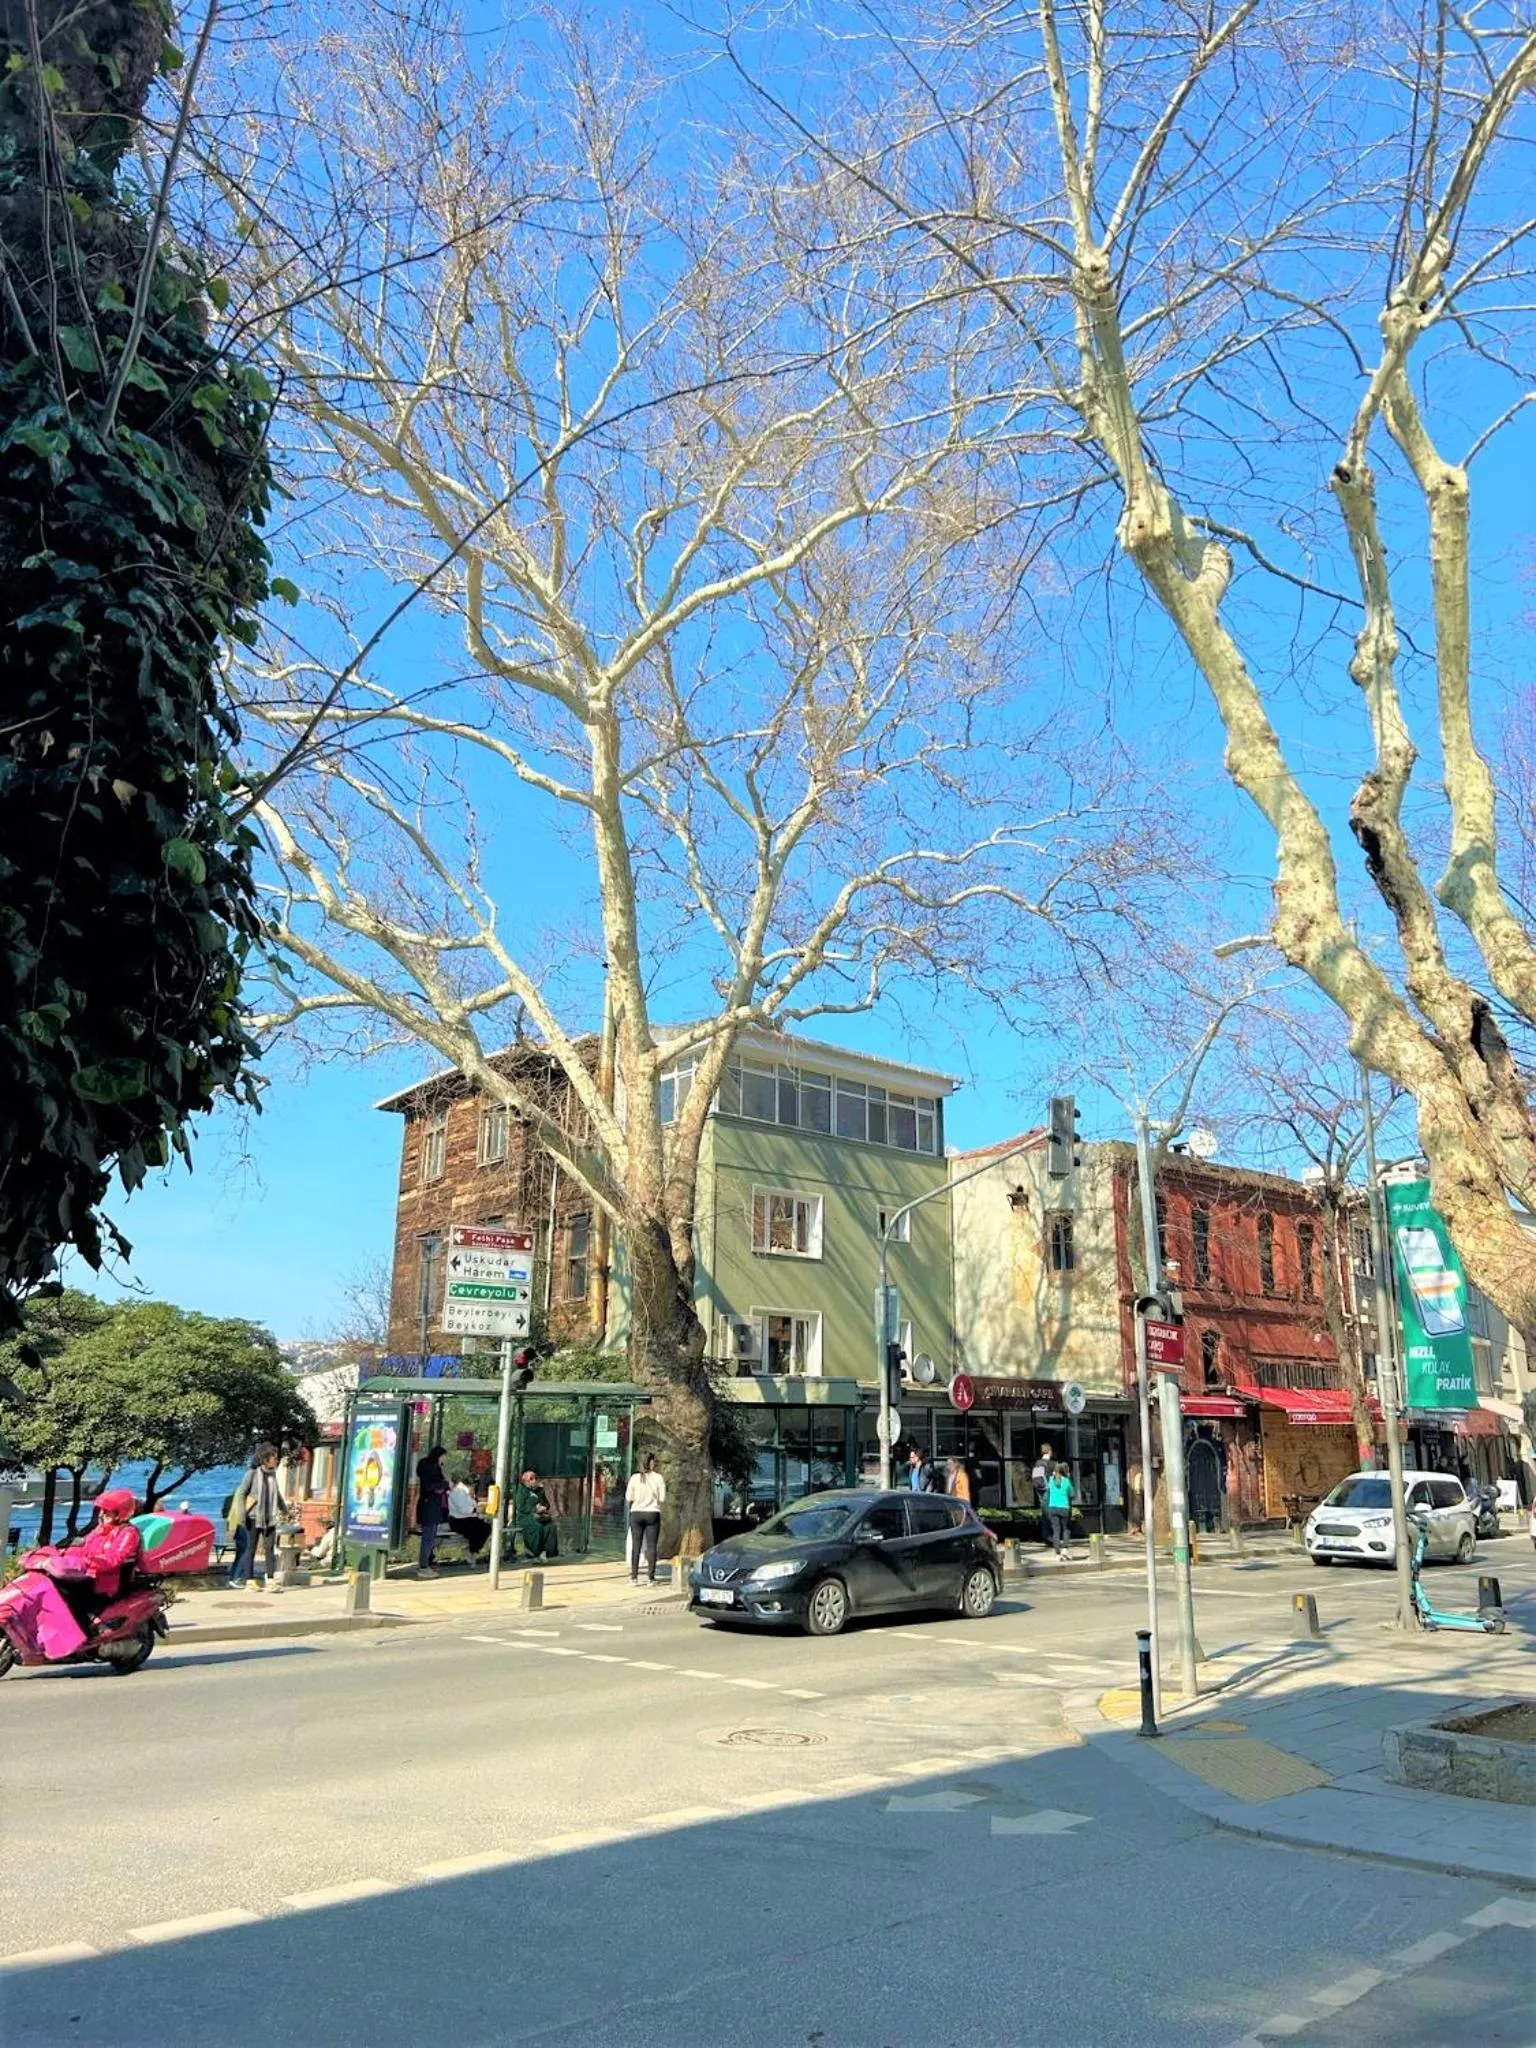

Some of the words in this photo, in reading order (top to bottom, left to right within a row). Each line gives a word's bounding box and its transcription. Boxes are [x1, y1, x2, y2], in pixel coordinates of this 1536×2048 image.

[463, 1266, 506, 1279] Harem
[448, 1306, 514, 1320] Beylerbeyi
[447, 1320, 492, 1331] Beykoz
[1436, 1373, 1472, 1391] PRATİK
